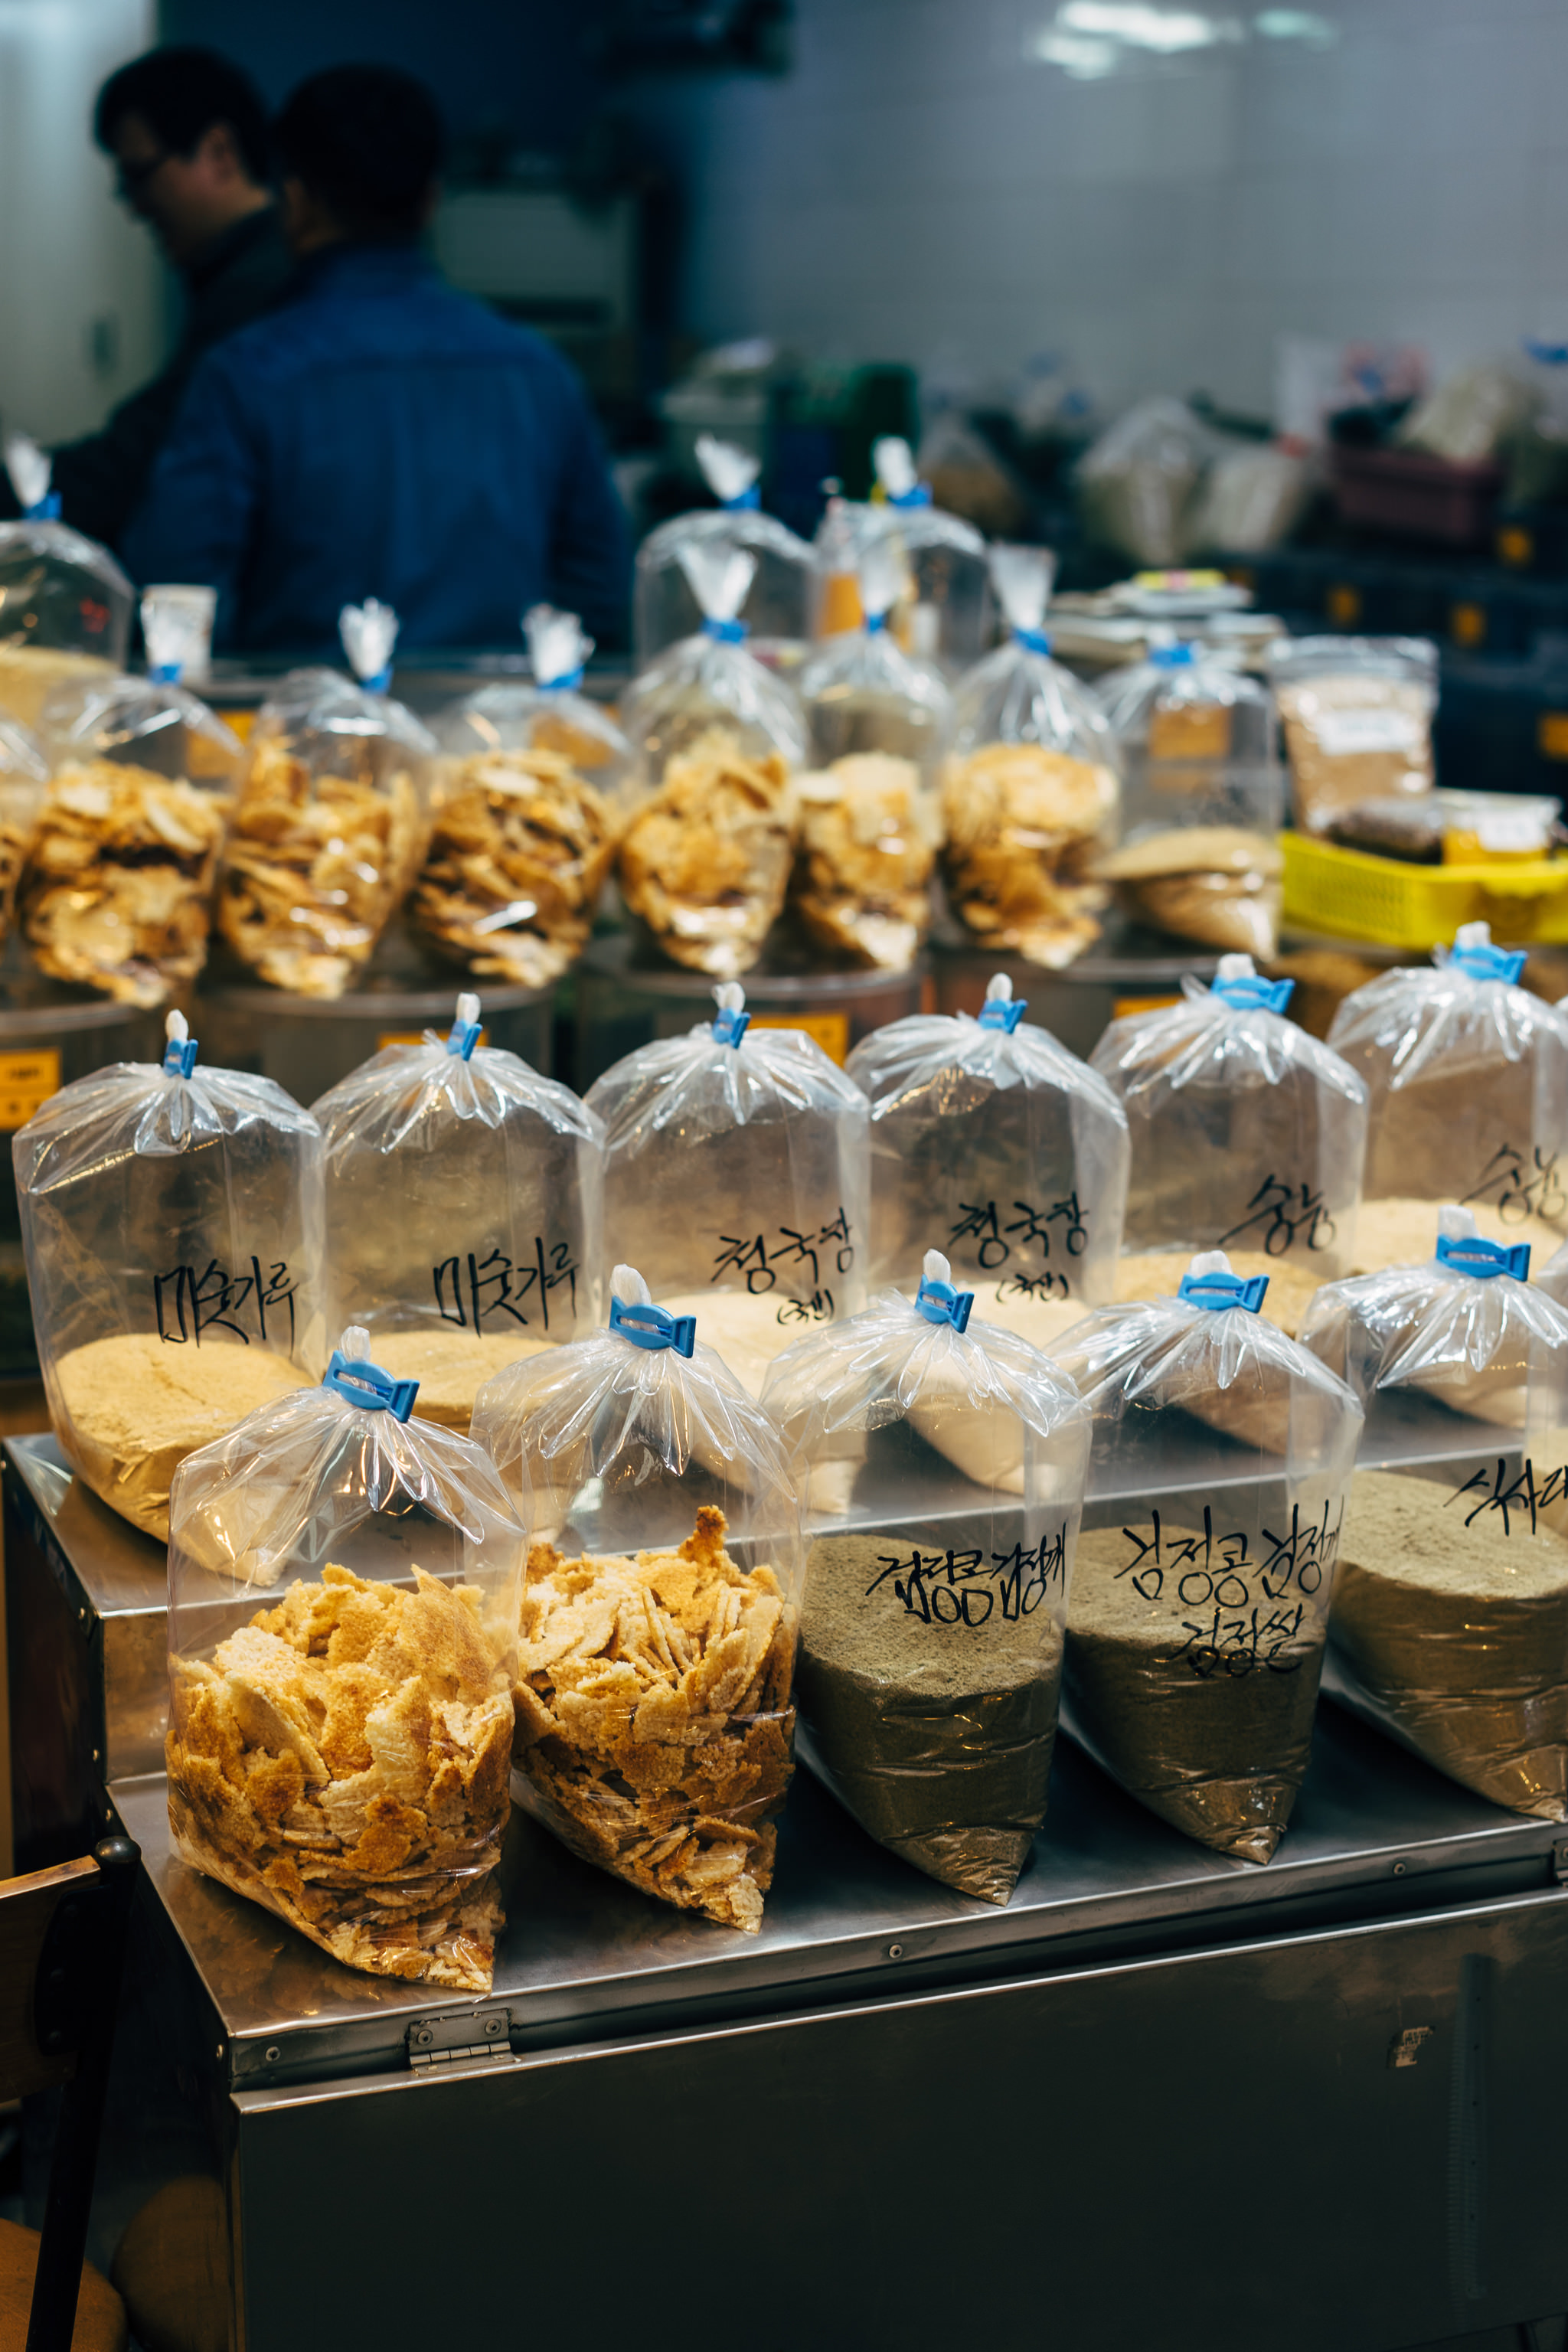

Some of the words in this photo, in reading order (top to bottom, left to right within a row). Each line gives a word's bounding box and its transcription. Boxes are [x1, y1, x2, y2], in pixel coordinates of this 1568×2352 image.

[710, 1207, 854, 1295] 청국장
[946, 1191, 1089, 1269] 청국장
[154, 1255, 300, 1361] 미숫가루
[433, 1236, 580, 1340] 미숫가루
